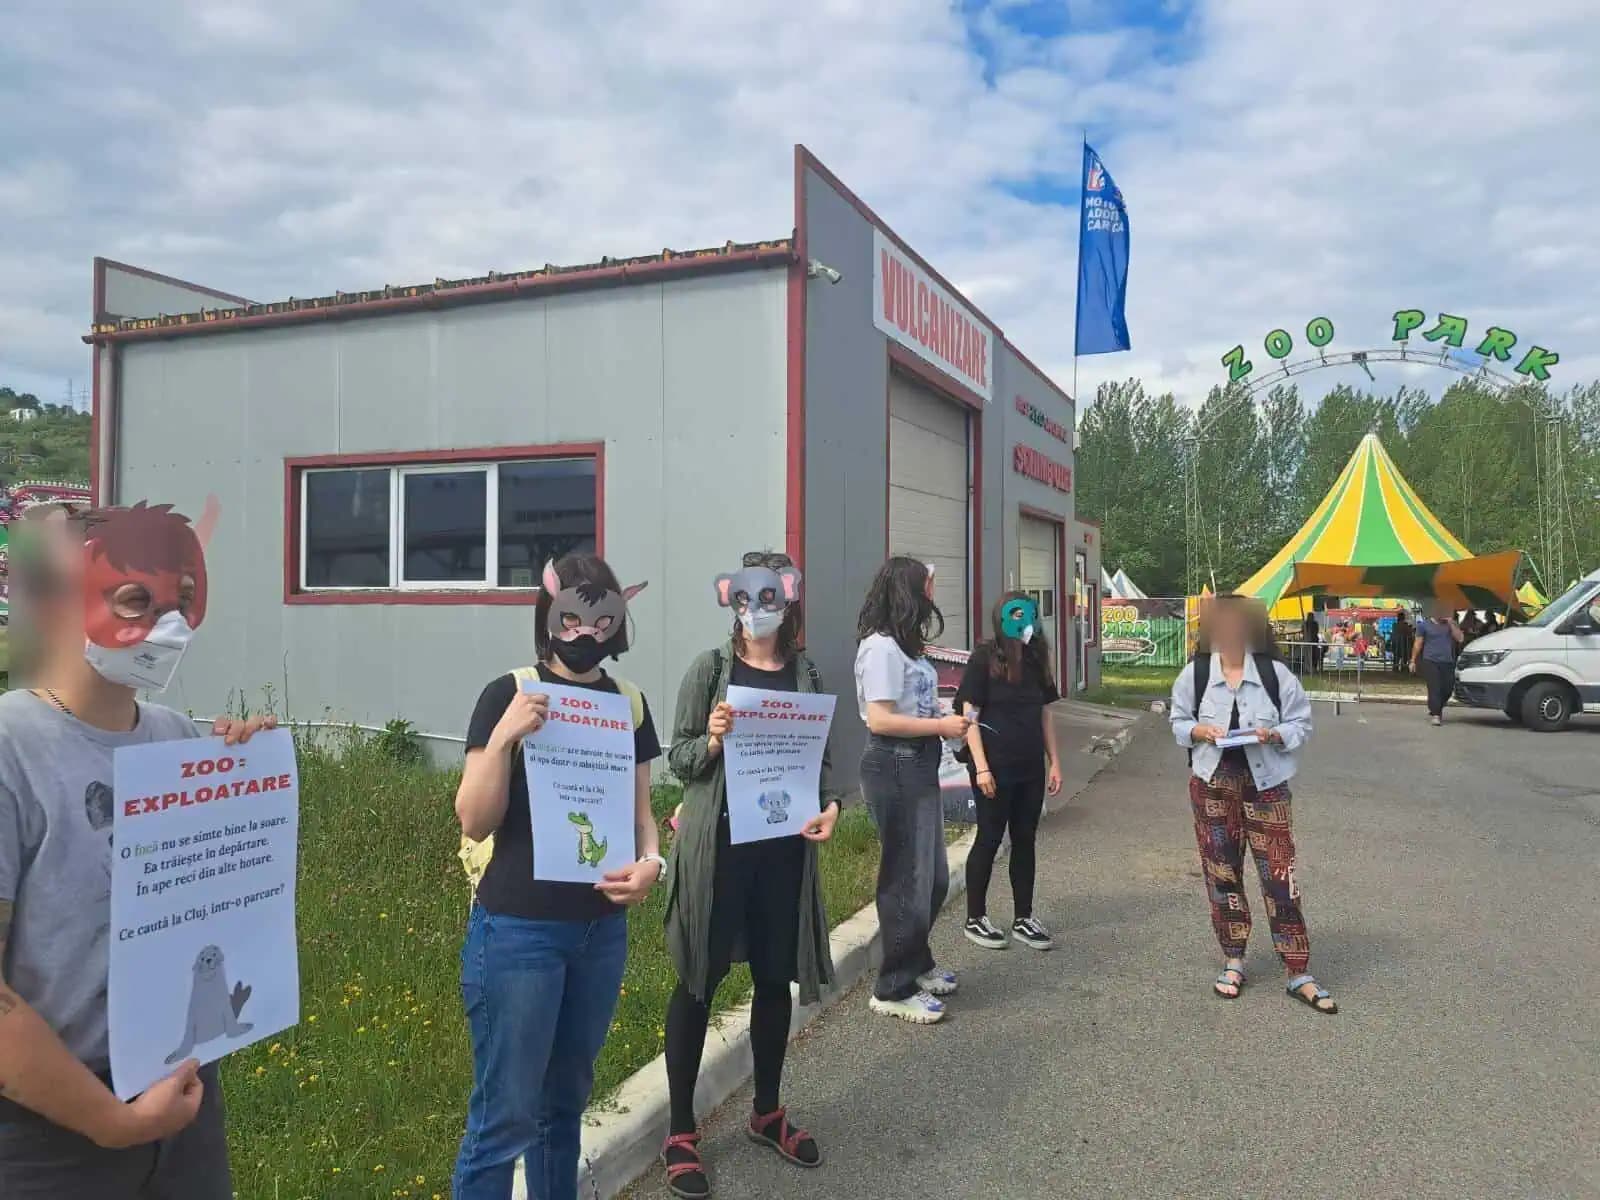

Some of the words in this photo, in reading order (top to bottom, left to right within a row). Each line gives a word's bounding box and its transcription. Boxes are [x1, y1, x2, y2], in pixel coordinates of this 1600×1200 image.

[881, 247, 988, 389] VULCANIZARE
[1221, 316, 1335, 383] ZOO
[1391, 308, 1560, 382] PARK
[1103, 607, 1136, 622] ZOO
[1103, 622, 1148, 638] ARK
[546, 711, 631, 731] PLOATARE
[560, 697, 600, 710] ZOO:
[180, 756, 247, 778] ZOO:
[124, 773, 292, 817] EXPLOATARE
[121, 846, 131, 860] O
[161, 838, 176, 851] nu
[179, 835, 191, 847] se
[192, 828, 222, 845] simte
[225, 822, 247, 839] bine
[249, 820, 258, 833] la
[260, 815, 289, 830] soare.
[144, 861, 158, 874] Ea
[160, 849, 203, 873] trăiește
[219, 836, 270, 859] depărtare.
[136, 880, 150, 896] În
[152, 877, 173, 896] ape
[174, 869, 196, 887] reci
[198, 865, 216, 880] din
[219, 861, 237, 876] alte
[240, 852, 274, 873] hotare.
[119, 927, 135, 941] Ce
[137, 916, 169, 937] caută
[171, 912, 181, 927] la
[184, 905, 209, 924] Cluj,
[244, 883, 285, 909] parcare?
